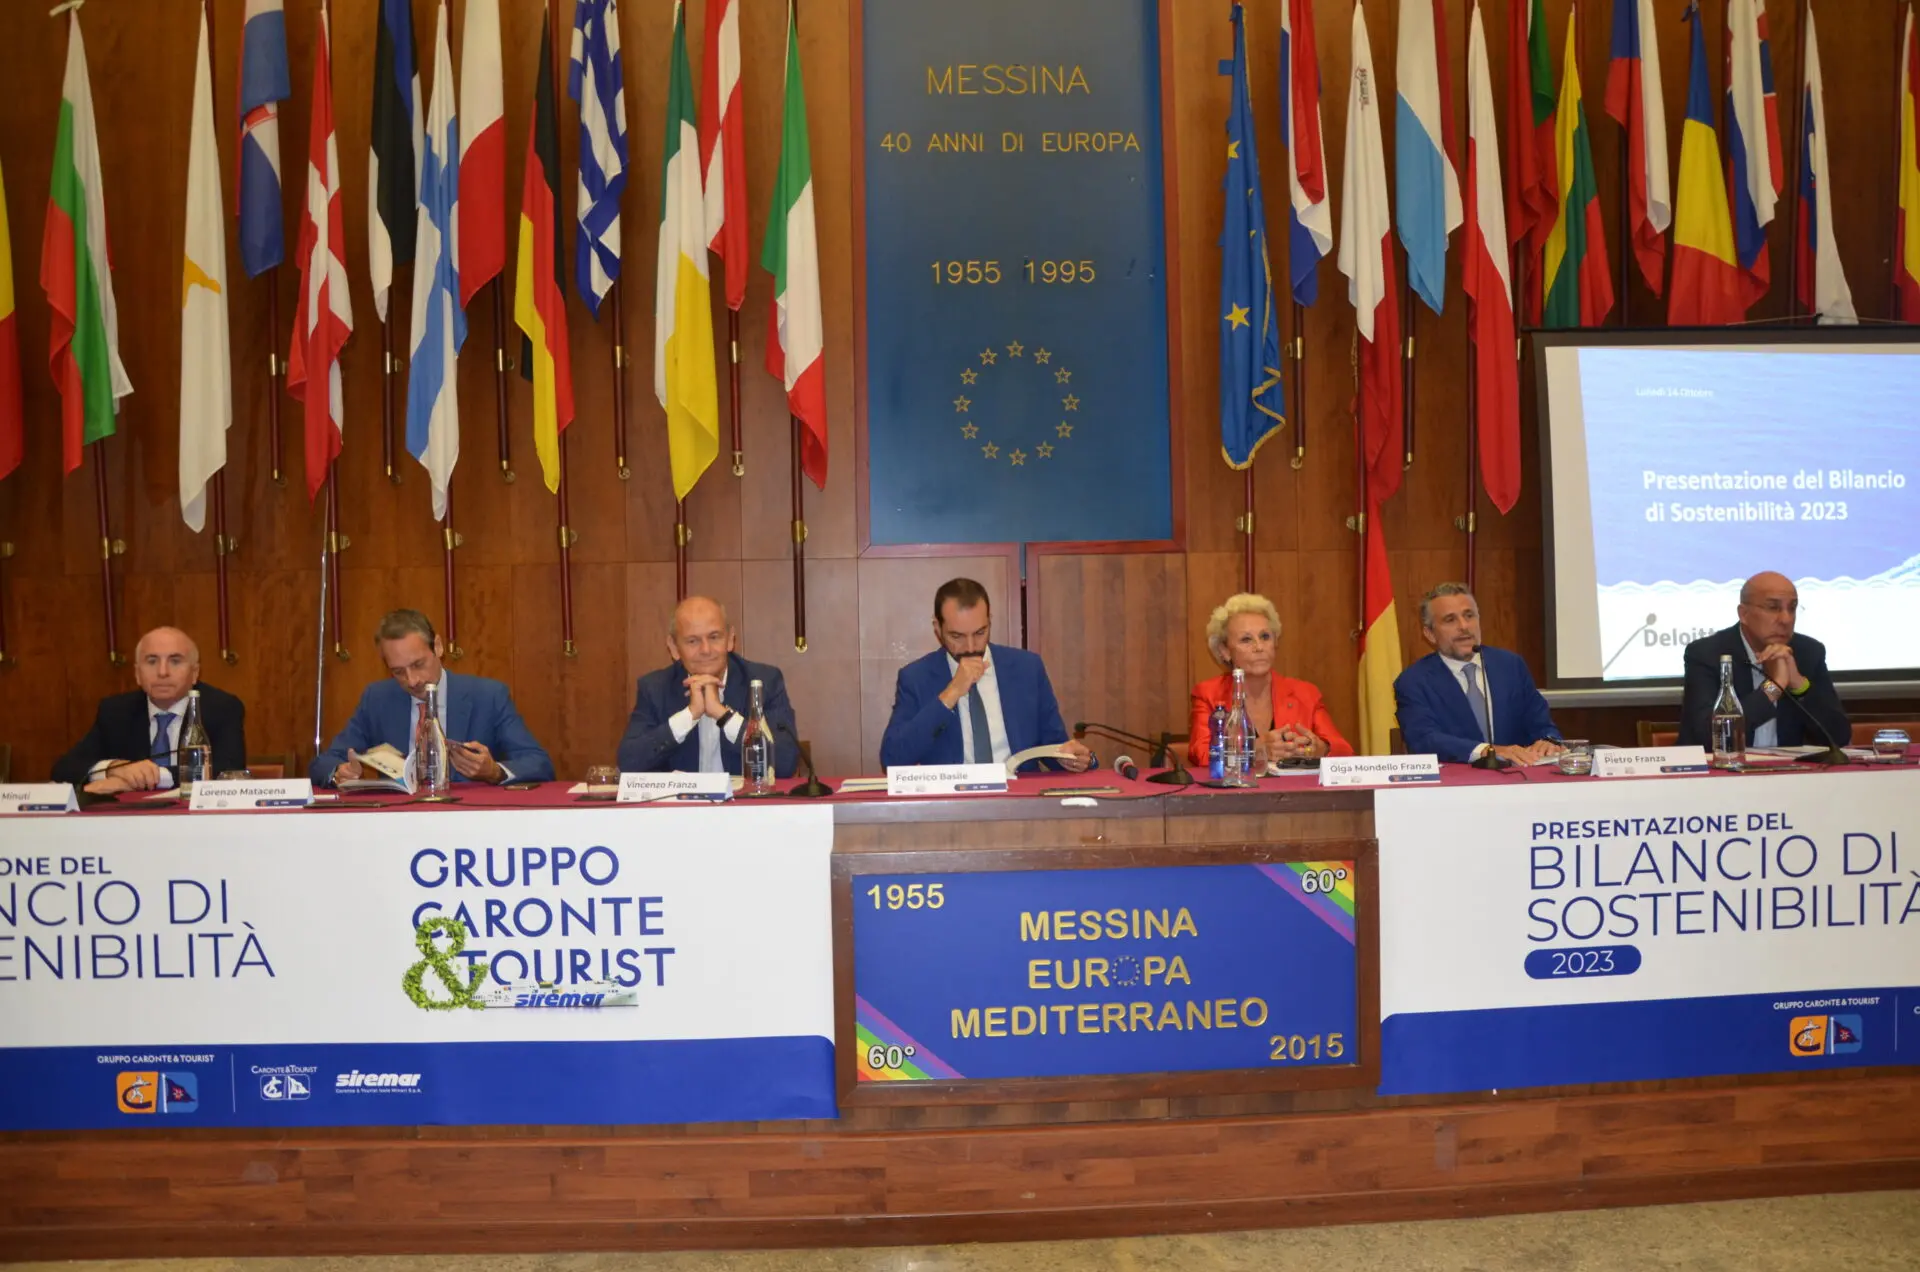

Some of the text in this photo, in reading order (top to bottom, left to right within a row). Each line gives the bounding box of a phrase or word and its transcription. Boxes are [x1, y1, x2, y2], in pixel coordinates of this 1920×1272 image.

[926, 64, 1091, 95] MESSINA
[879, 131, 1141, 153] 40 ANNI DI EUROPA
[931, 260, 1096, 284] 1955 1995
[1643, 468, 1906, 490] Presentazione del Bilancio
[1645, 501, 1849, 522] di Sostenibilità 2023
[1330, 761, 1432, 773] Olga Mondello Franza
[1604, 755, 1666, 764] Pietro Franza
[626, 780, 697, 789] Vincenzo Franza
[896, 772, 969, 782] Federico Basile
[2, 790, 31, 800] Minuti
[199, 786, 286, 796] Lorenzo Matacena
[1532, 812, 1793, 840] PRESENTAZIONE DEL
[60, 856, 112, 875] DEL
[410, 845, 619, 888] GRUPPO
[1530, 831, 1897, 890] BILANCIO DI
[1301, 868, 1347, 894] 60°
[168, 879, 228, 924] DI
[867, 883, 945, 910] 1955
[412, 896, 664, 938] CARONTE
[1020, 907, 1198, 942] MESSINA
[457, 947, 676, 988] TOURIST
[1551, 950, 1615, 975] 2023
[514, 990, 605, 1007] siremar
[1773, 1001, 1804, 1010] GRUPPO
[1804, 999, 1840, 1008] CARONTE
[1848, 997, 1880, 1005] TOURIST
[951, 997, 1268, 1039] MEDITERRANEO
[867, 1044, 916, 1070] 60°
[1269, 1032, 1344, 1060] 2015
[132, 1055, 172, 1063] CARONTE
[180, 1054, 215, 1062] TOURIST
[336, 1069, 421, 1087] siremar
